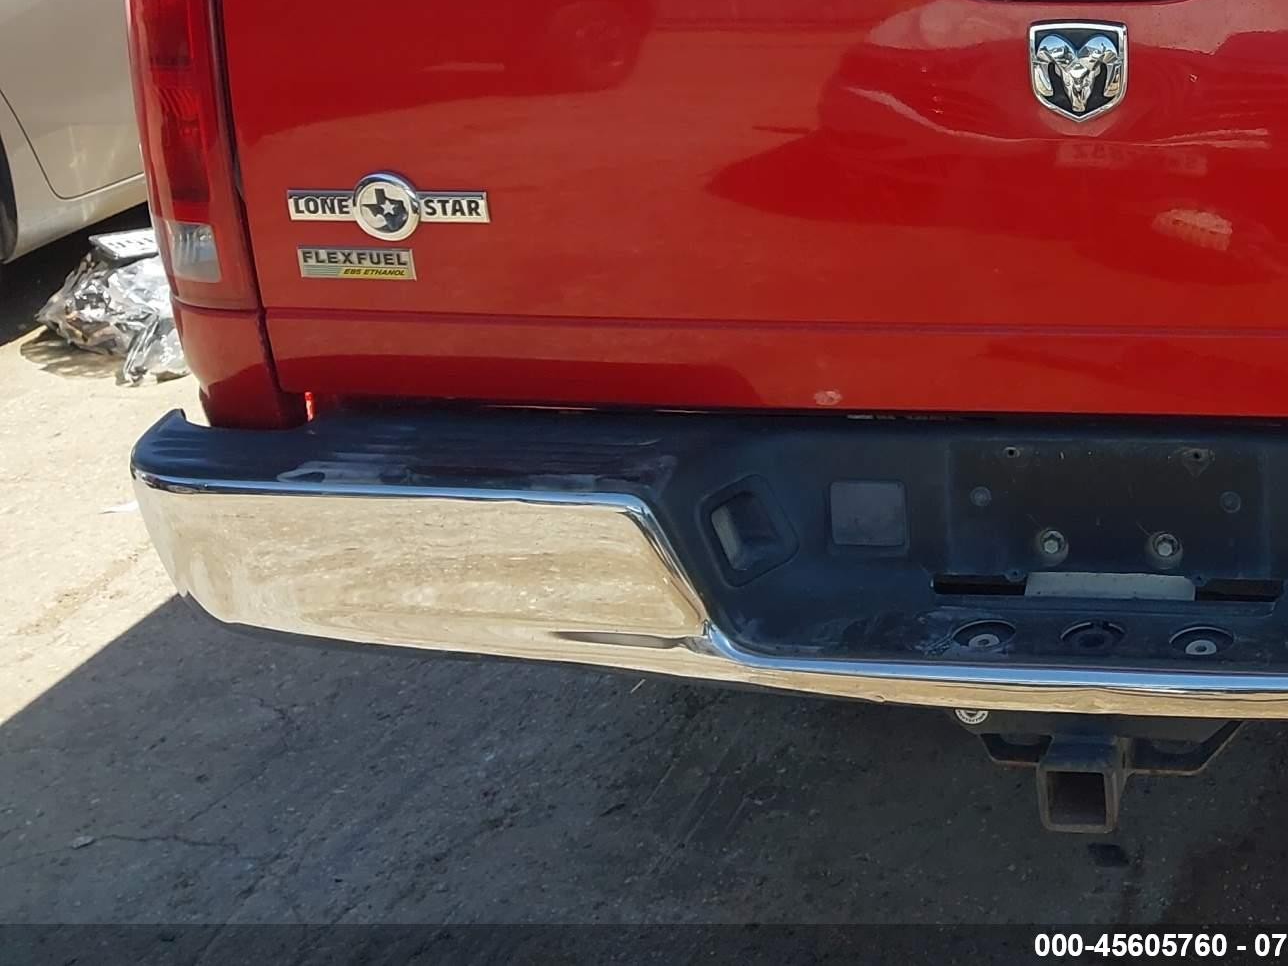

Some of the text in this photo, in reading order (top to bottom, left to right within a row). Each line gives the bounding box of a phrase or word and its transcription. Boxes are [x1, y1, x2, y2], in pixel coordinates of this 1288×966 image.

[293, 196, 482, 217] LONE STAR
[303, 251, 408, 266] FLEXFUEL
[343, 267, 406, 276] E85 ETHANOL
